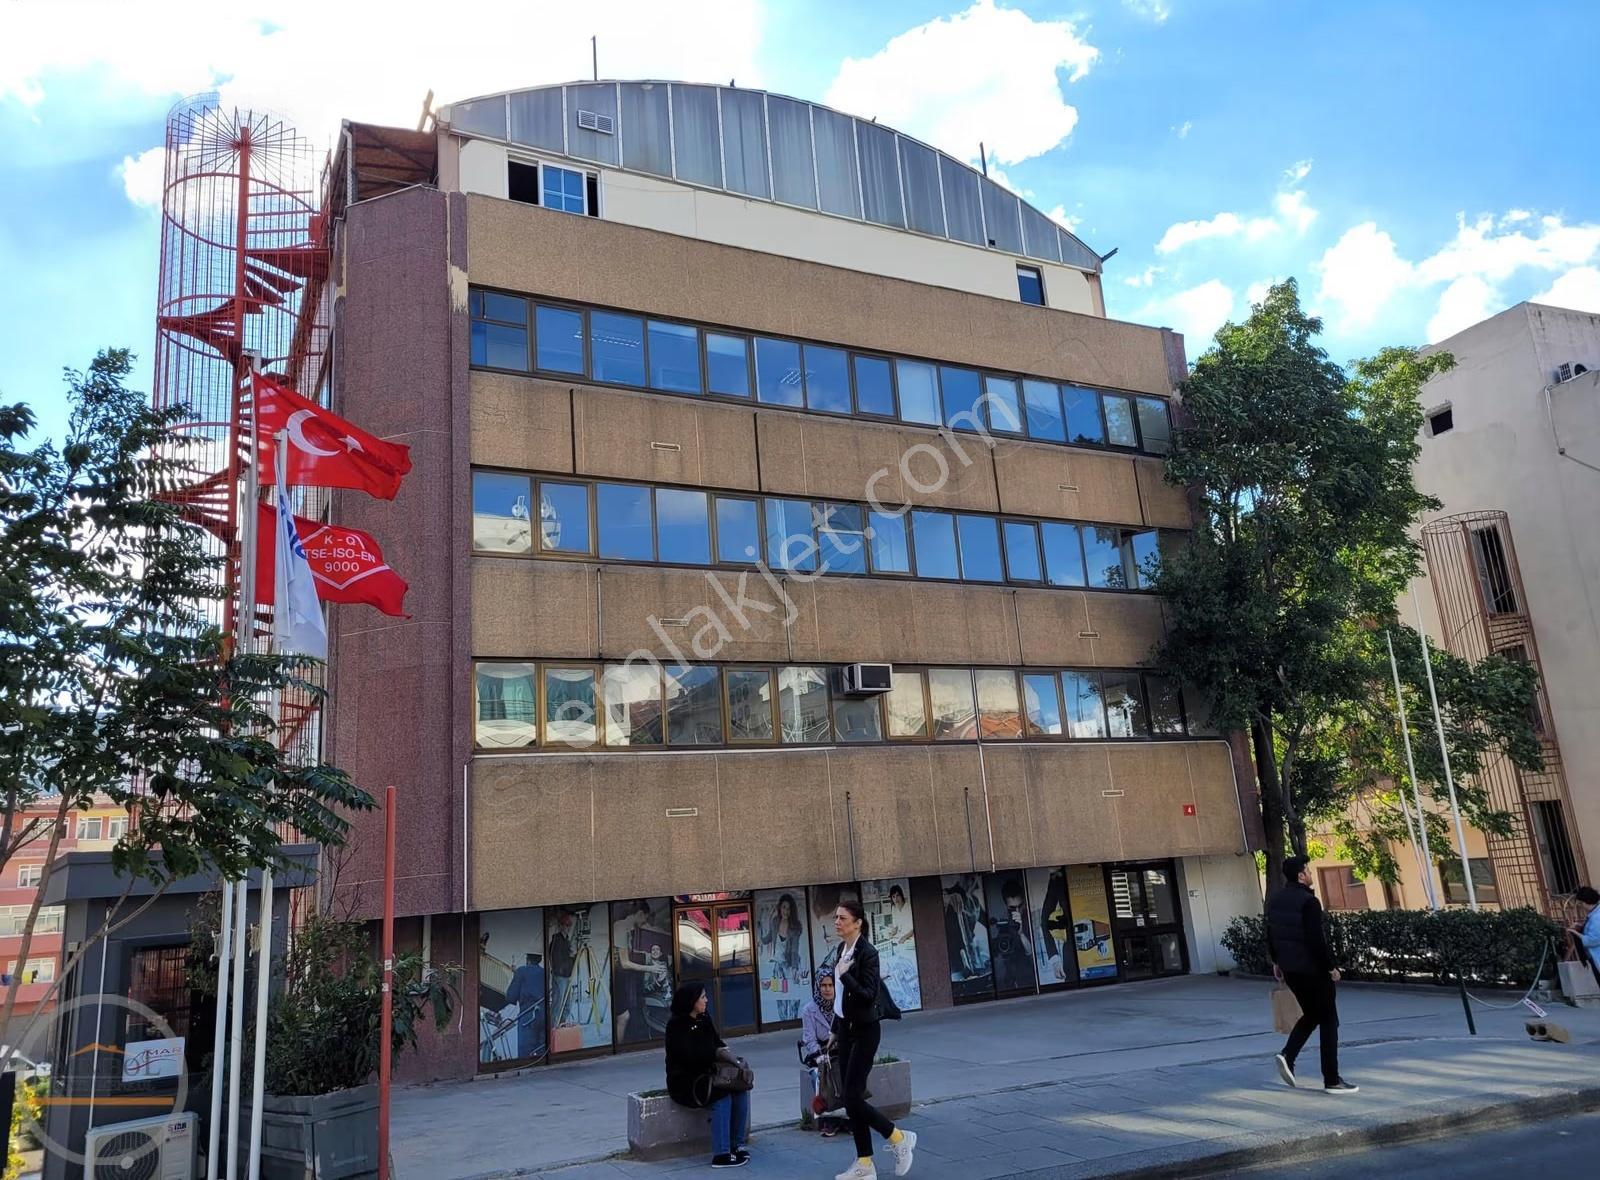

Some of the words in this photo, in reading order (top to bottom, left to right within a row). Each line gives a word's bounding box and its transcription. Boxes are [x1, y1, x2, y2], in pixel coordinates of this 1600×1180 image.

[324, 535, 333, 545] K
[345, 535, 356, 546] Q
[304, 548, 376, 563] TSE-ISO-EN
[324, 561, 360, 573] 9000
